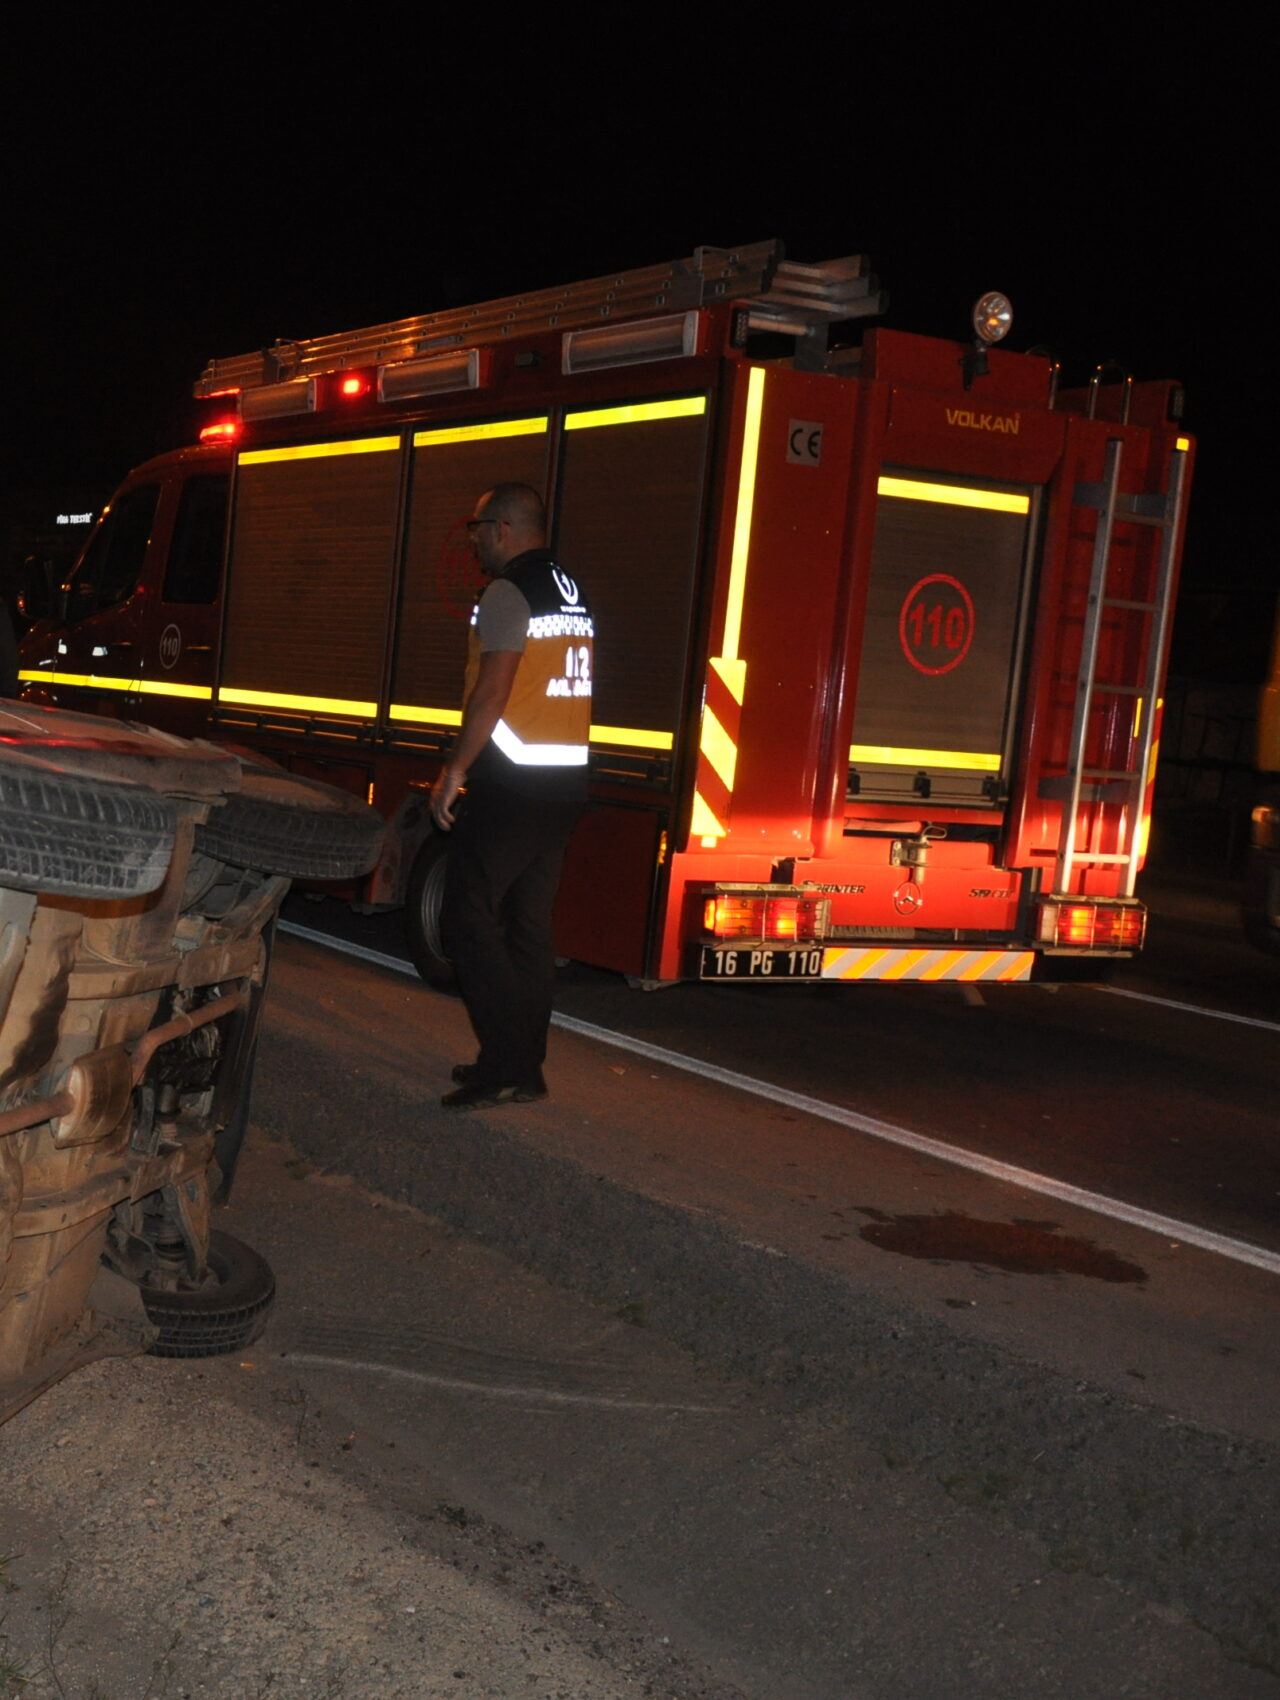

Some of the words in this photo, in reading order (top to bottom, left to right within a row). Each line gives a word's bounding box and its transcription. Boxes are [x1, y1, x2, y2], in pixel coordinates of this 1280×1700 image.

[945, 408, 1019, 434] VOLKAN
[791, 428, 821, 458] CE
[910, 602, 964, 649] 110
[163, 637, 178, 656] 110
[715, 951, 737, 975] 16
[749, 951, 773, 975] PG
[788, 951, 820, 975] 110
